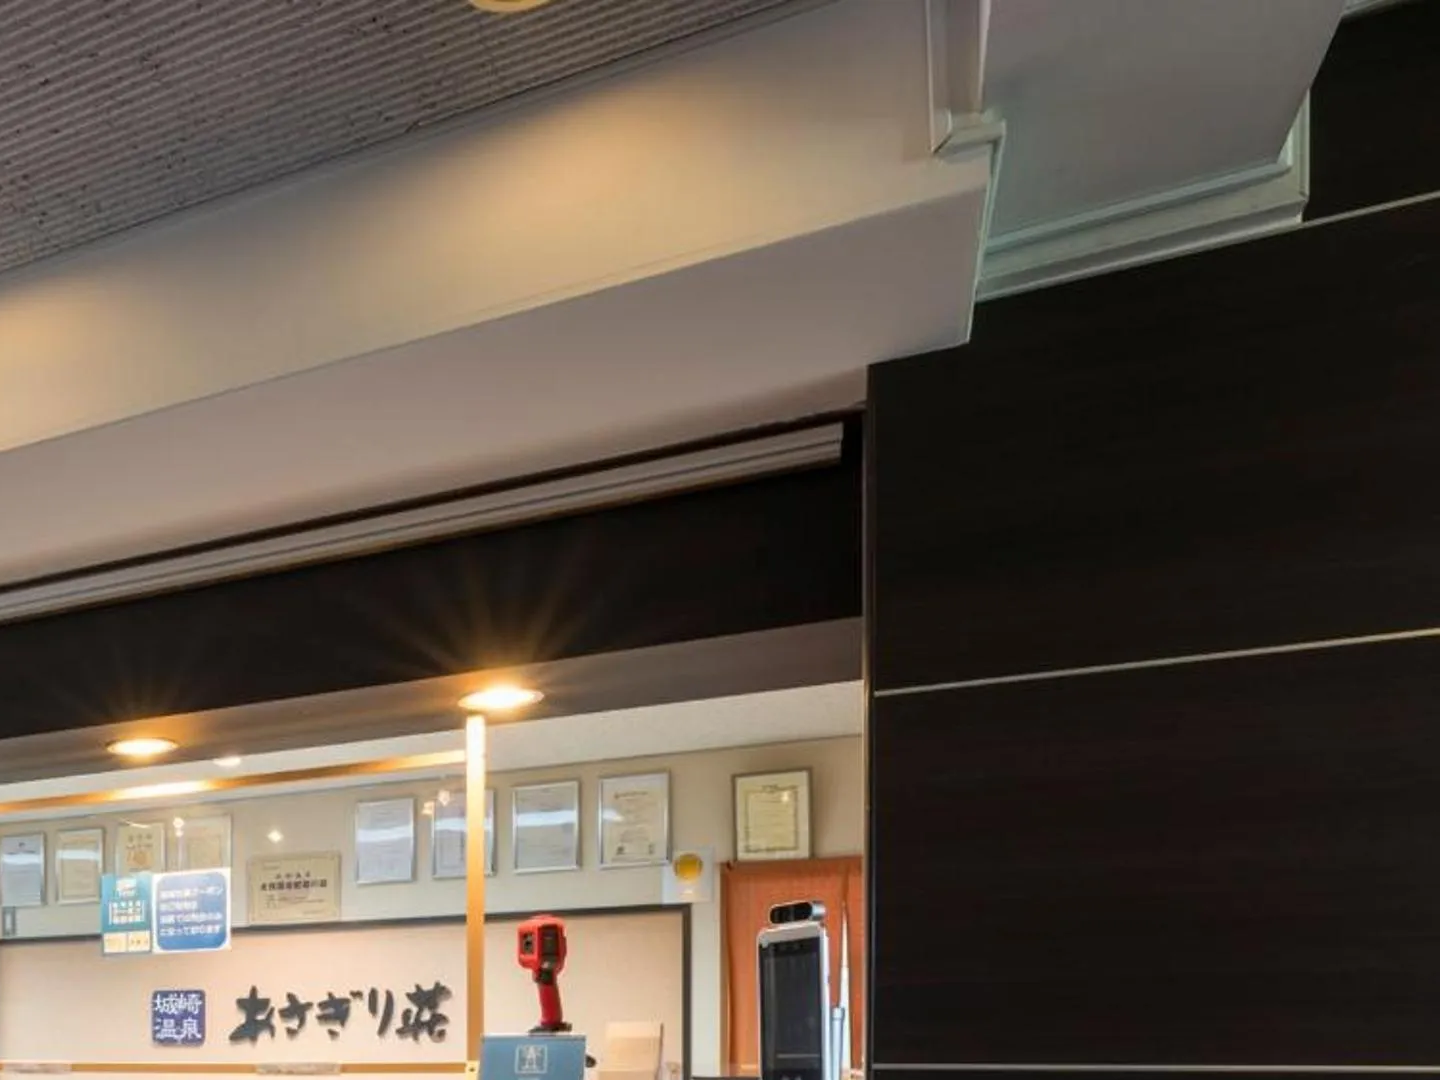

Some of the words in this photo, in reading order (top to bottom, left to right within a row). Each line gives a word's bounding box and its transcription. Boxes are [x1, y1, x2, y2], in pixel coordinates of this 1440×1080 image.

[154, 992, 203, 1016] 城崎
[229, 982, 453, 1045] あさぎり荘
[155, 1018, 202, 1043] 温泉
